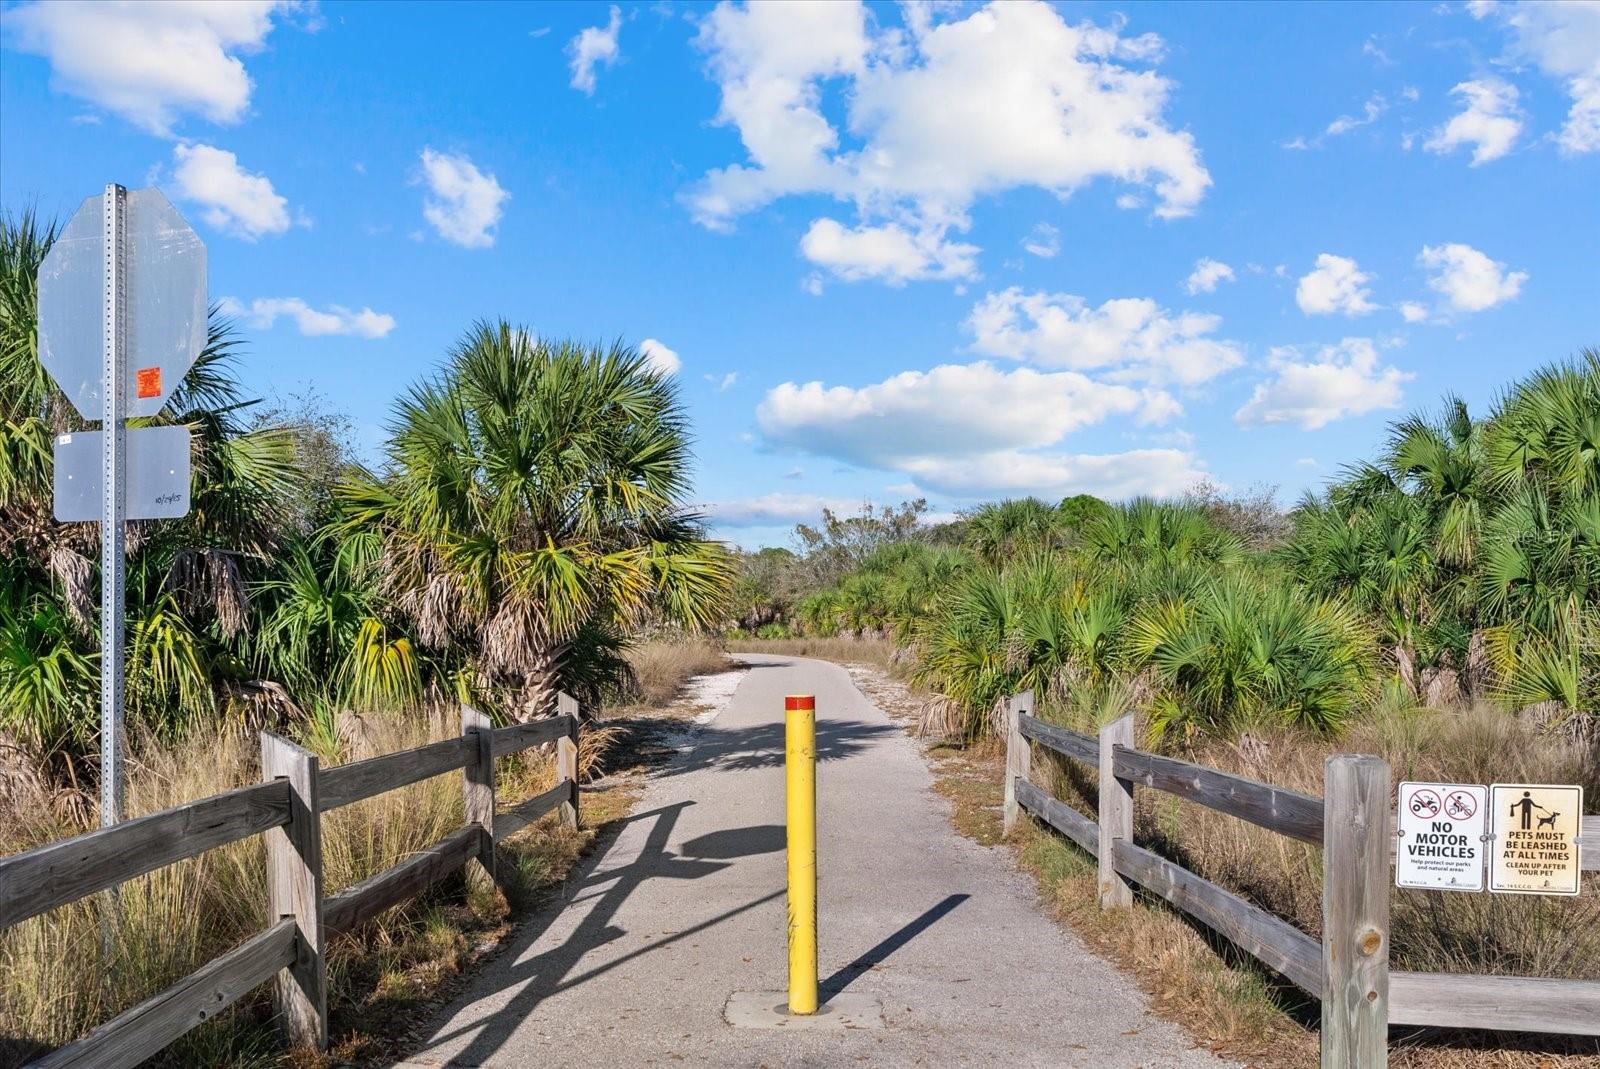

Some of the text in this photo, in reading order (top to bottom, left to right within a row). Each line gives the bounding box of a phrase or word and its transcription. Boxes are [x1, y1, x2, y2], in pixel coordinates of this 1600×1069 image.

[1432, 822, 1453, 833] NO
[1416, 833, 1468, 846] MOTOR
[1509, 831, 1565, 840] PETS MUST
[1521, 842, 1567, 850] LEASHED
[1408, 845, 1475, 859] VEHICLES
[1538, 852, 1570, 860] TIMES
